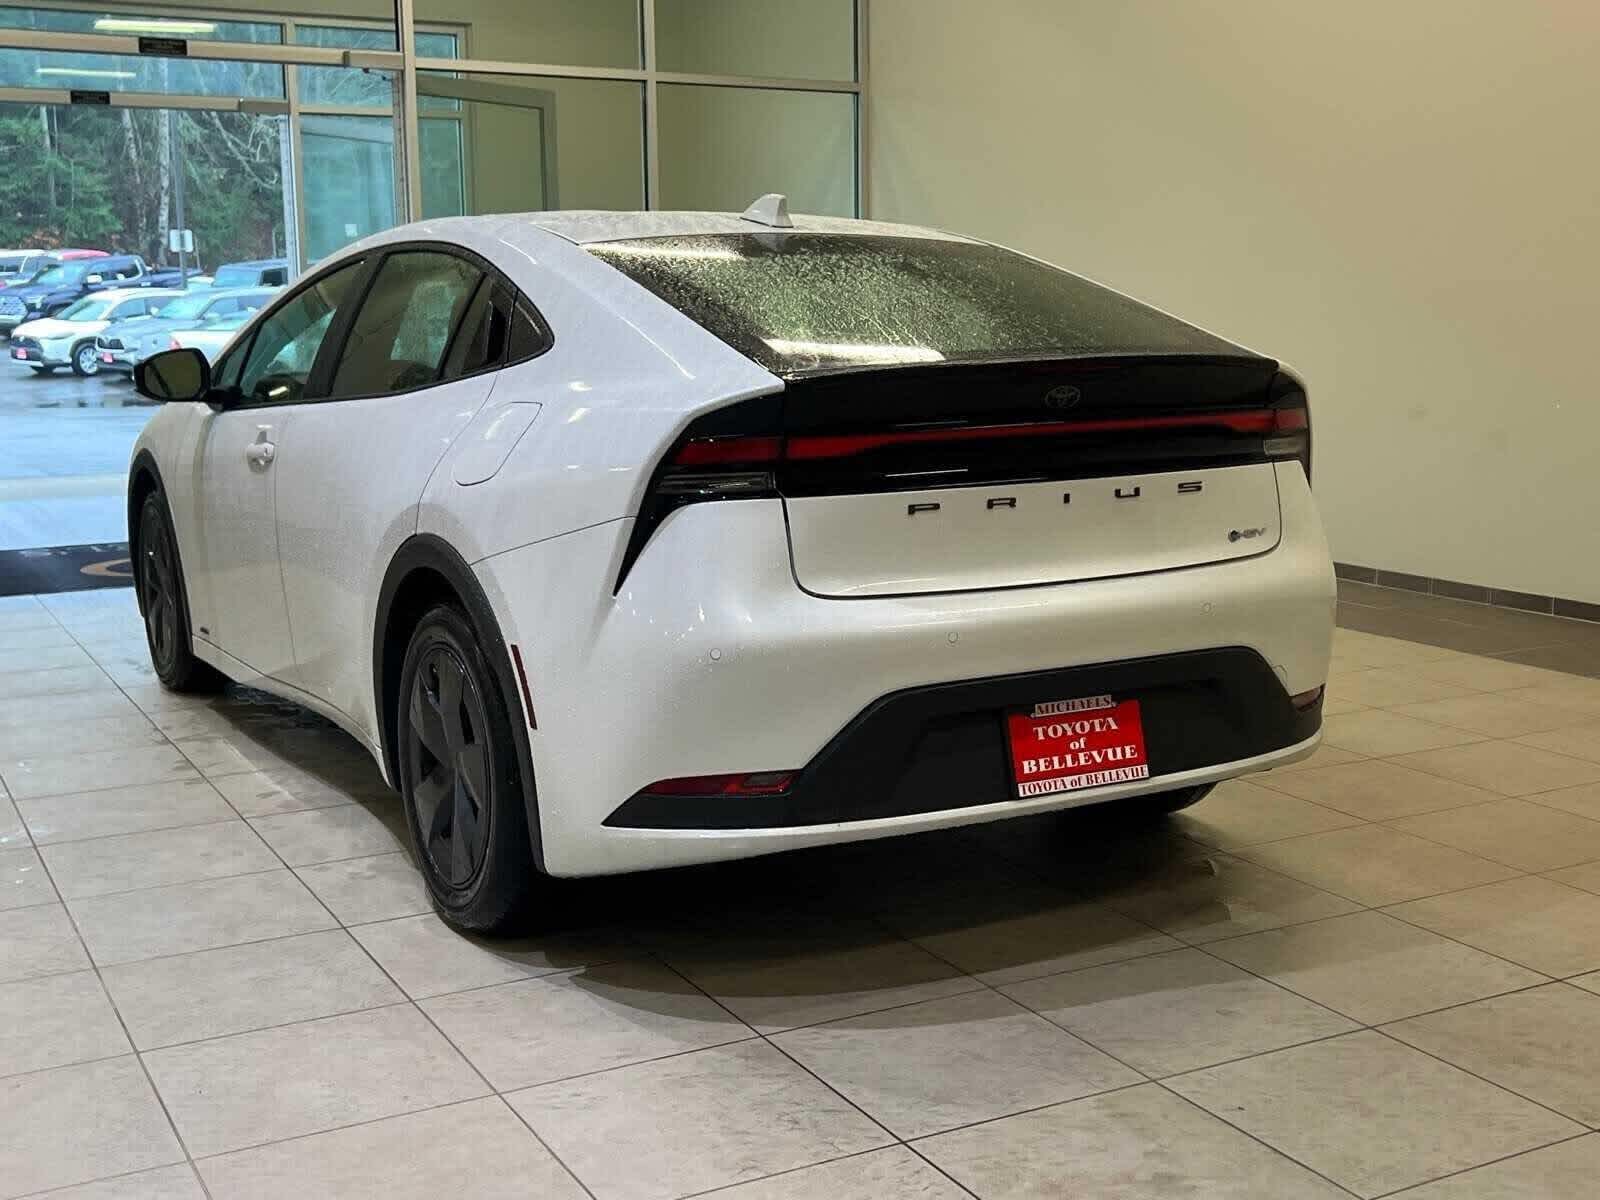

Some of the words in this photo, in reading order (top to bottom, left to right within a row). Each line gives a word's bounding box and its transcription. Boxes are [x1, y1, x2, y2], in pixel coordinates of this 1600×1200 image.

[908, 481, 1202, 515] PRIUS
[1033, 717, 1119, 740] TOYOTA
[1070, 737, 1087, 750] of
[1022, 745, 1138, 774] BELLEVUE
[1020, 780, 1067, 796] TOYOTA
[1071, 775, 1083, 788] of
[1087, 766, 1147, 785] BELLEVUE
